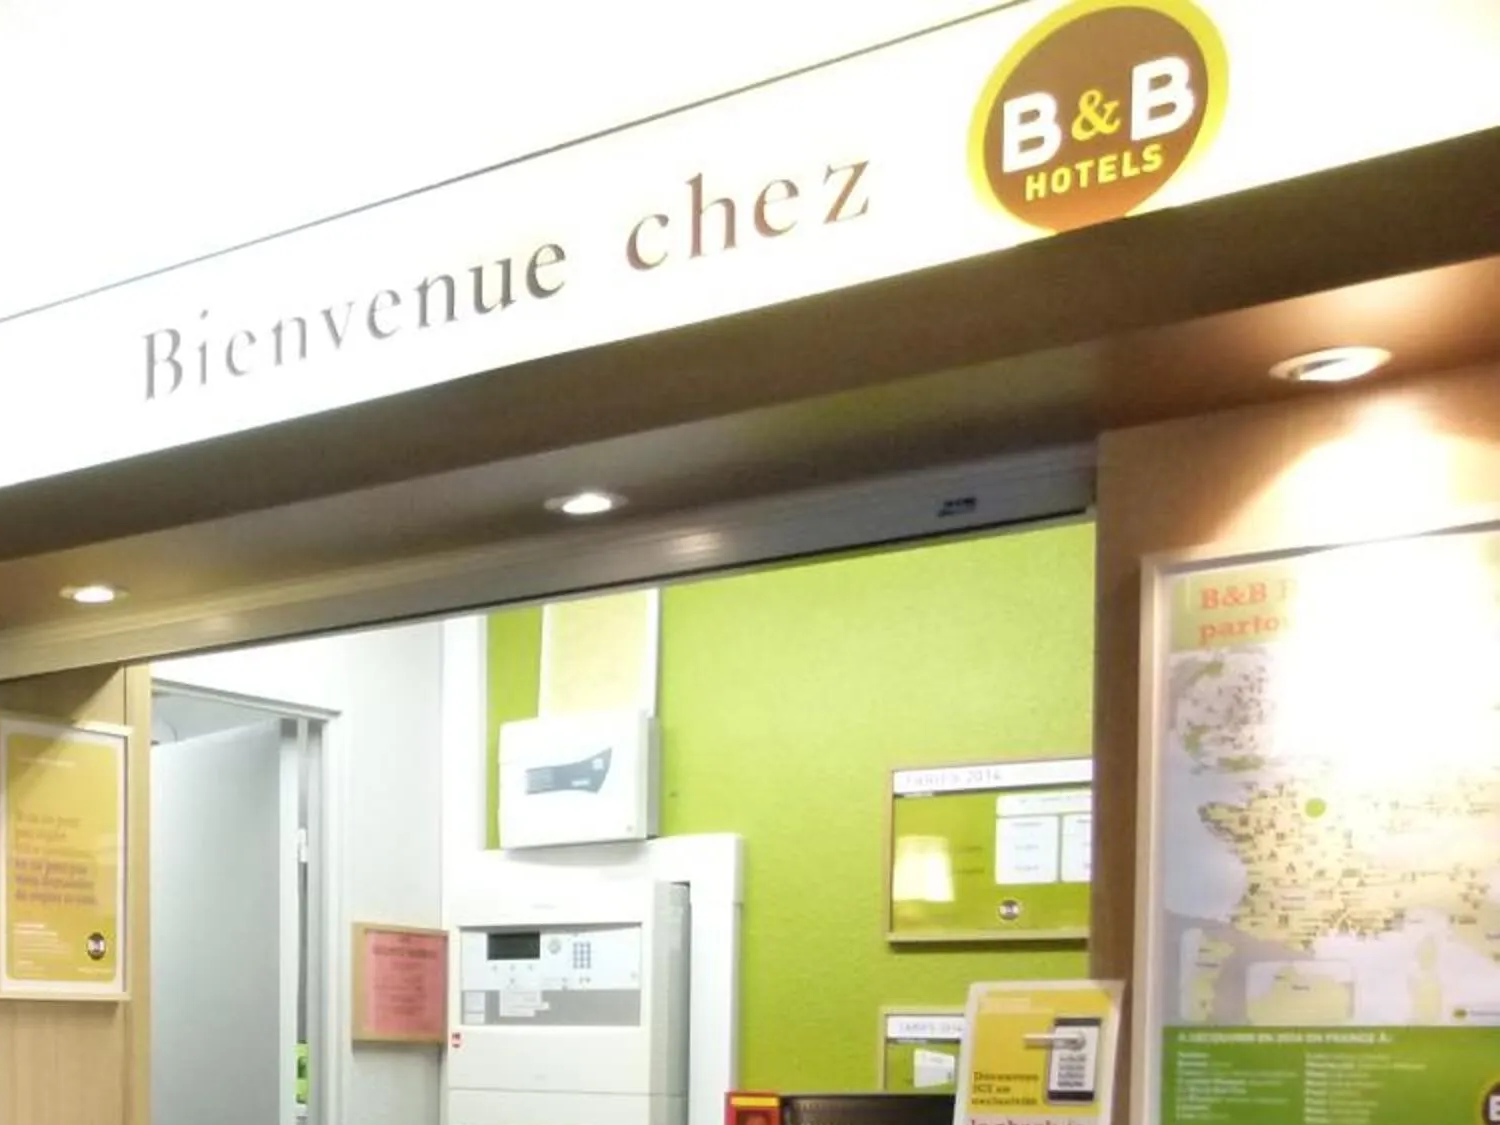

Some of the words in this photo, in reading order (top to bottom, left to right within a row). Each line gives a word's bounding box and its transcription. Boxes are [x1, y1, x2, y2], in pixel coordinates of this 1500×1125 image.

[1002, 54, 1195, 174] B&B
[1024, 143, 1164, 202] HOTELS
[140, 241, 568, 401] Bienvenue
[626, 159, 871, 272] chez
